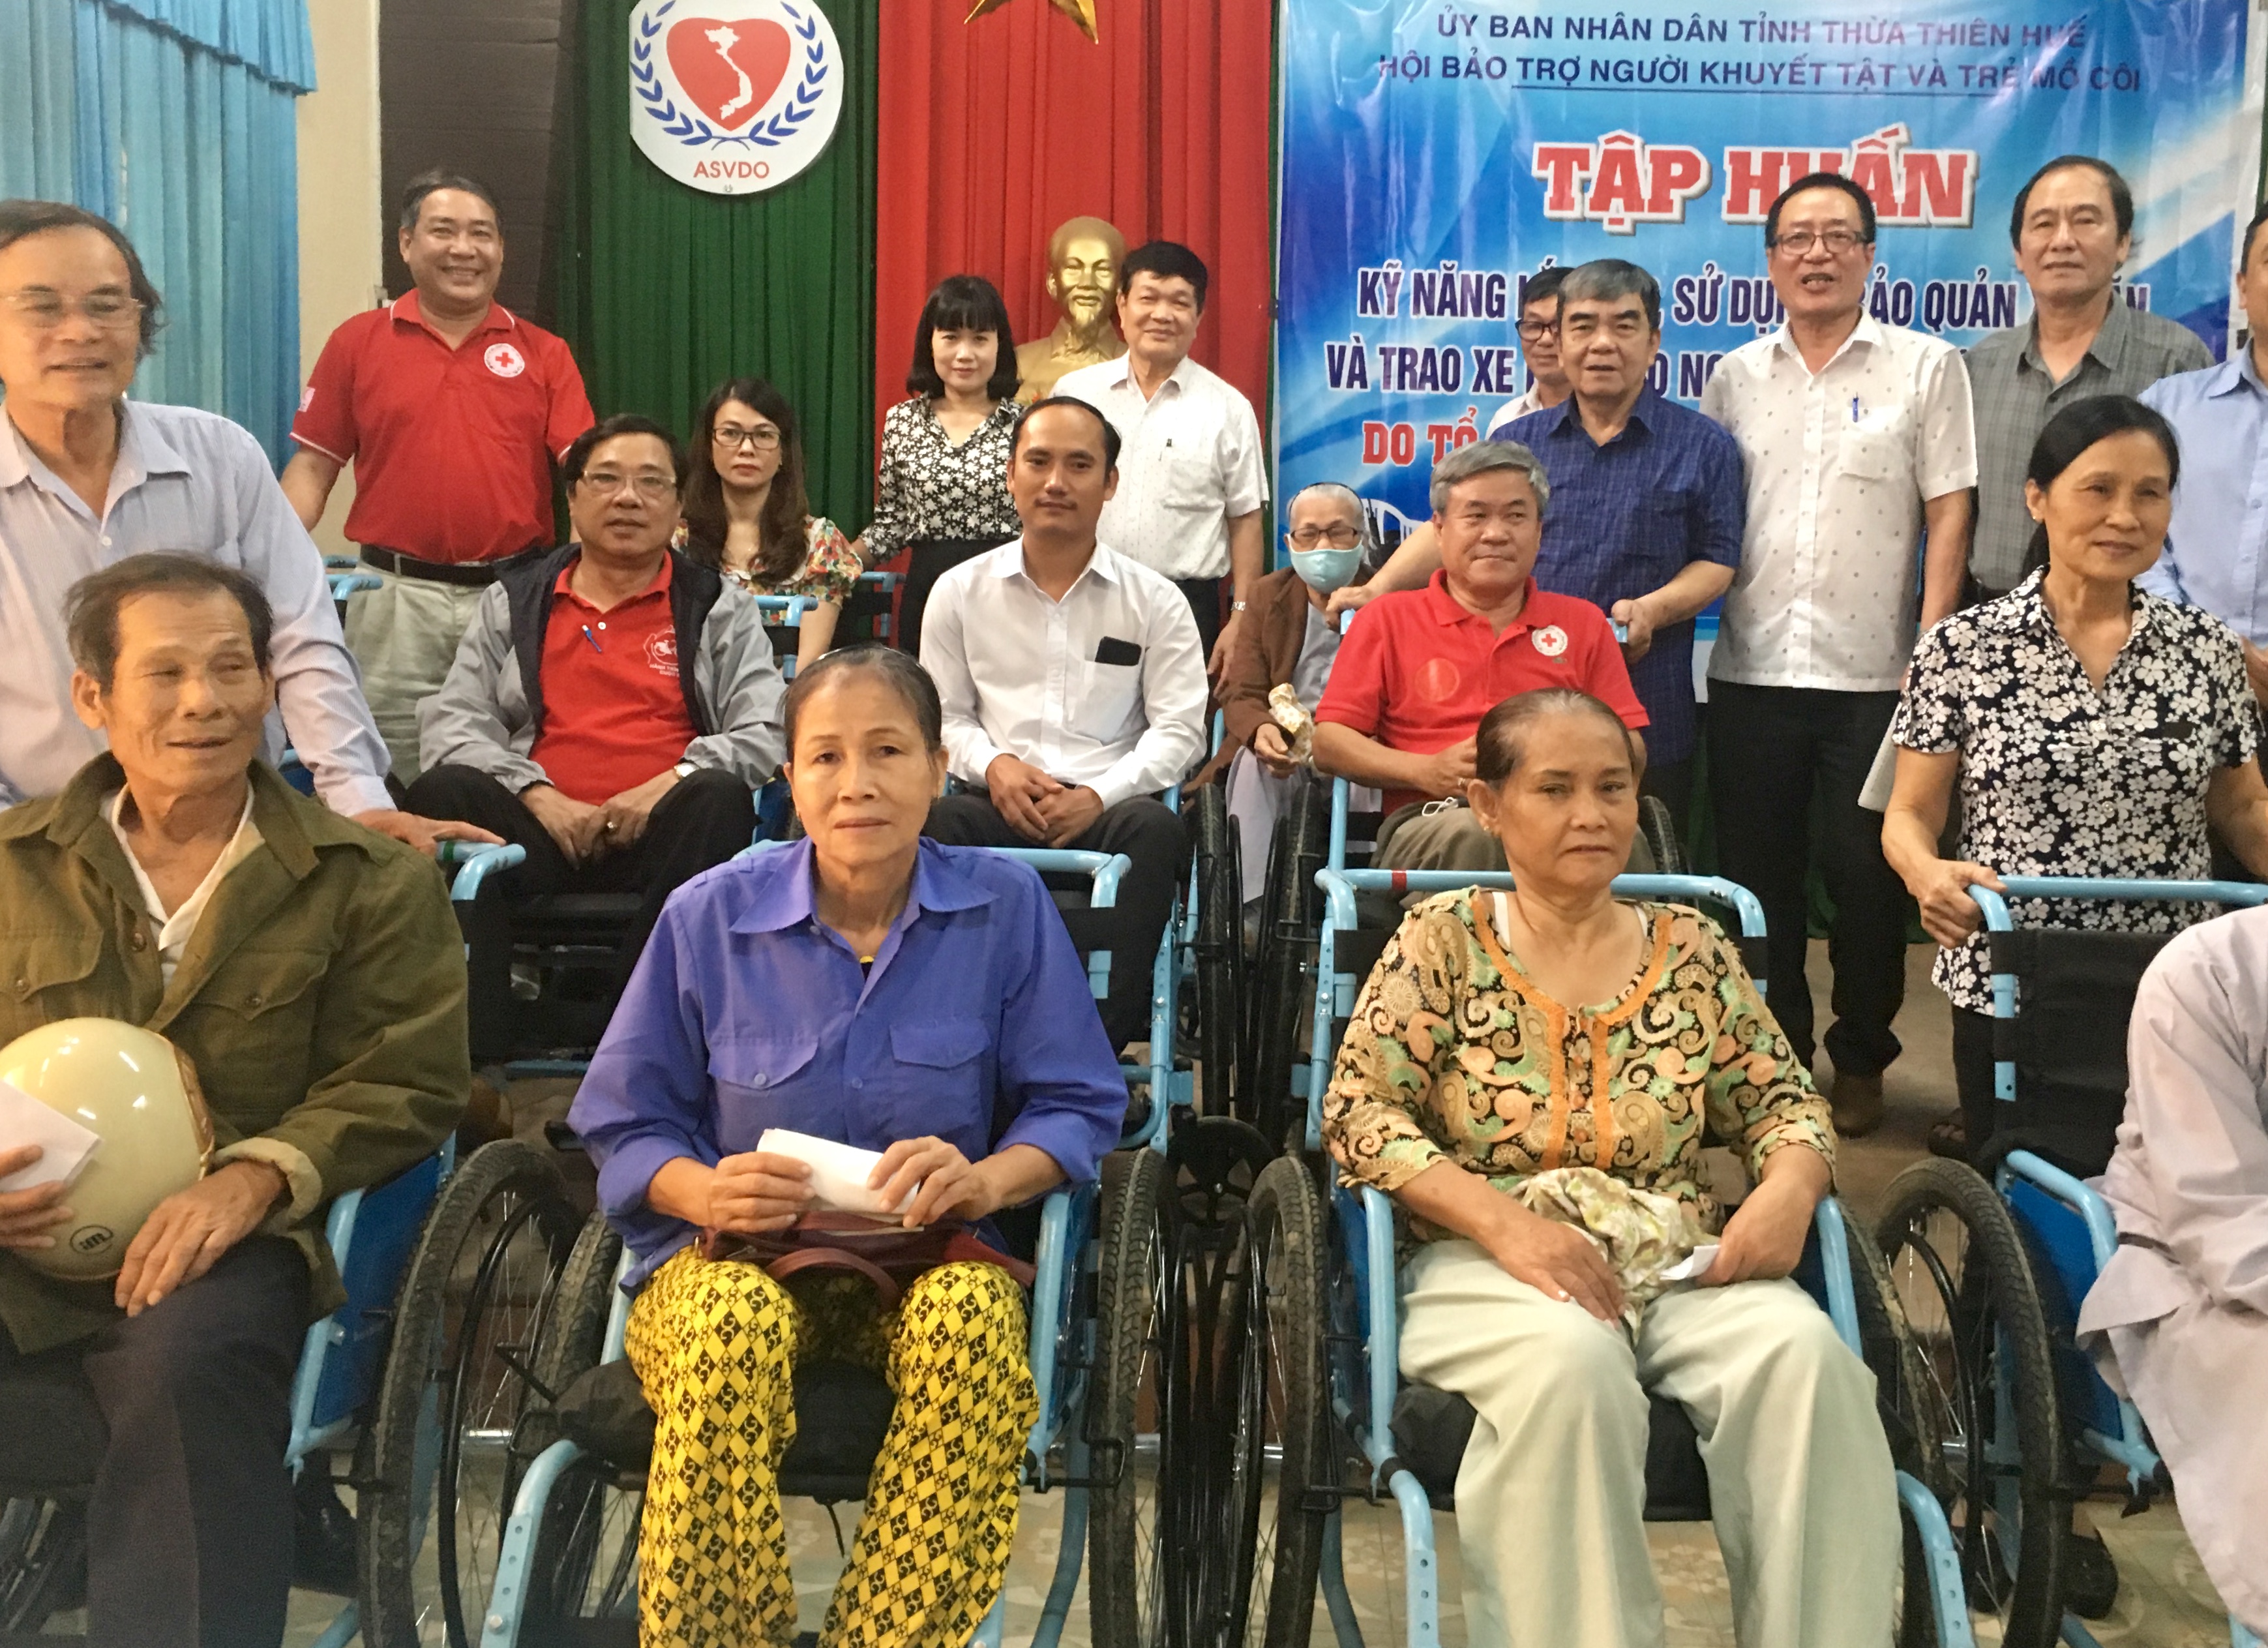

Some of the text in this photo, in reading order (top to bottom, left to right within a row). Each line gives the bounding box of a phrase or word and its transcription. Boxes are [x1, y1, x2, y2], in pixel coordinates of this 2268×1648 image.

[1438, 4, 1478, 37] ỦY
[1489, 14, 1553, 38] BAN
[1565, 11, 1652, 40] NHÂN
[1664, 12, 1727, 42] DÂN
[1738, 10, 1811, 44] TỈNH
[1821, 15, 1905, 44] THỪA
[1917, 18, 2010, 46] THIÊN
[1379, 50, 1431, 83] HỘI
[1442, 47, 1507, 80] BẢO
[1516, 55, 1581, 86] TRỢ
[1590, 53, 1688, 83] NGƯỜI
[1700, 53, 1827, 85] KHUYẾT
[1837, 57, 1897, 92] TẬT
[1907, 58, 1947, 87] VÀ
[1958, 57, 2018, 88] TRẺ
[2090, 63, 2140, 92] CÔI
[693, 160, 770, 179] ASVDO
[1537, 134, 1703, 227] TẬP
[1360, 262, 1402, 316] KỸ
[1412, 263, 1506, 318] NĂNG
[1674, 263, 1724, 324] SỬ
[1860, 265, 1913, 327] ẢO
[1924, 267, 2016, 333] QUẢN
[1326, 335, 1368, 389] VÀ
[1379, 347, 1461, 393] TRAO
[1472, 349, 1514, 394] XE
[1362, 423, 1415, 466] DO
